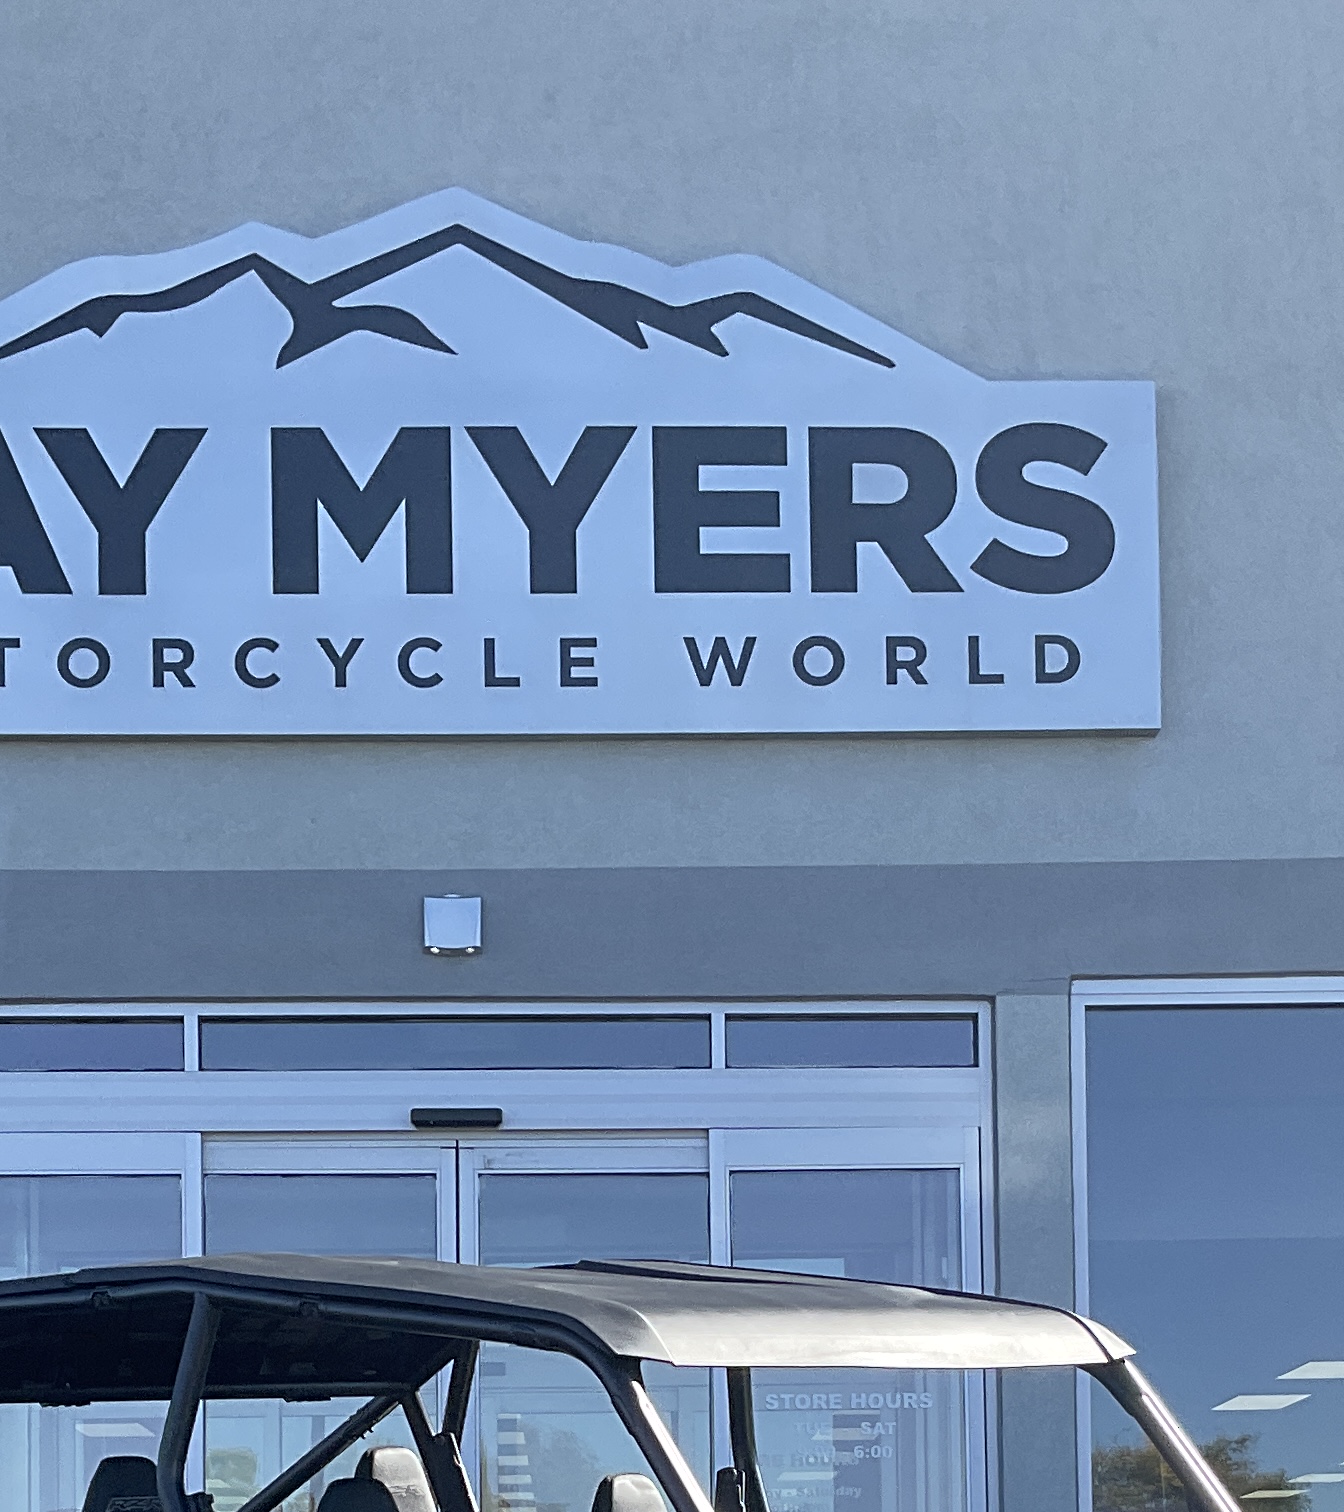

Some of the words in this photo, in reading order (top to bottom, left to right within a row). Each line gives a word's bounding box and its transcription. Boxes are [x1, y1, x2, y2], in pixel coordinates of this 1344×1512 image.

[271, 423, 1116, 595] MYERS
[682, 635, 1081, 687] WORLD
[765, 1394, 842, 1410] STORE
[850, 1392, 934, 1409] HOURS
[860, 1421, 897, 1435] SAT
[853, 1445, 894, 1459] 6:00
